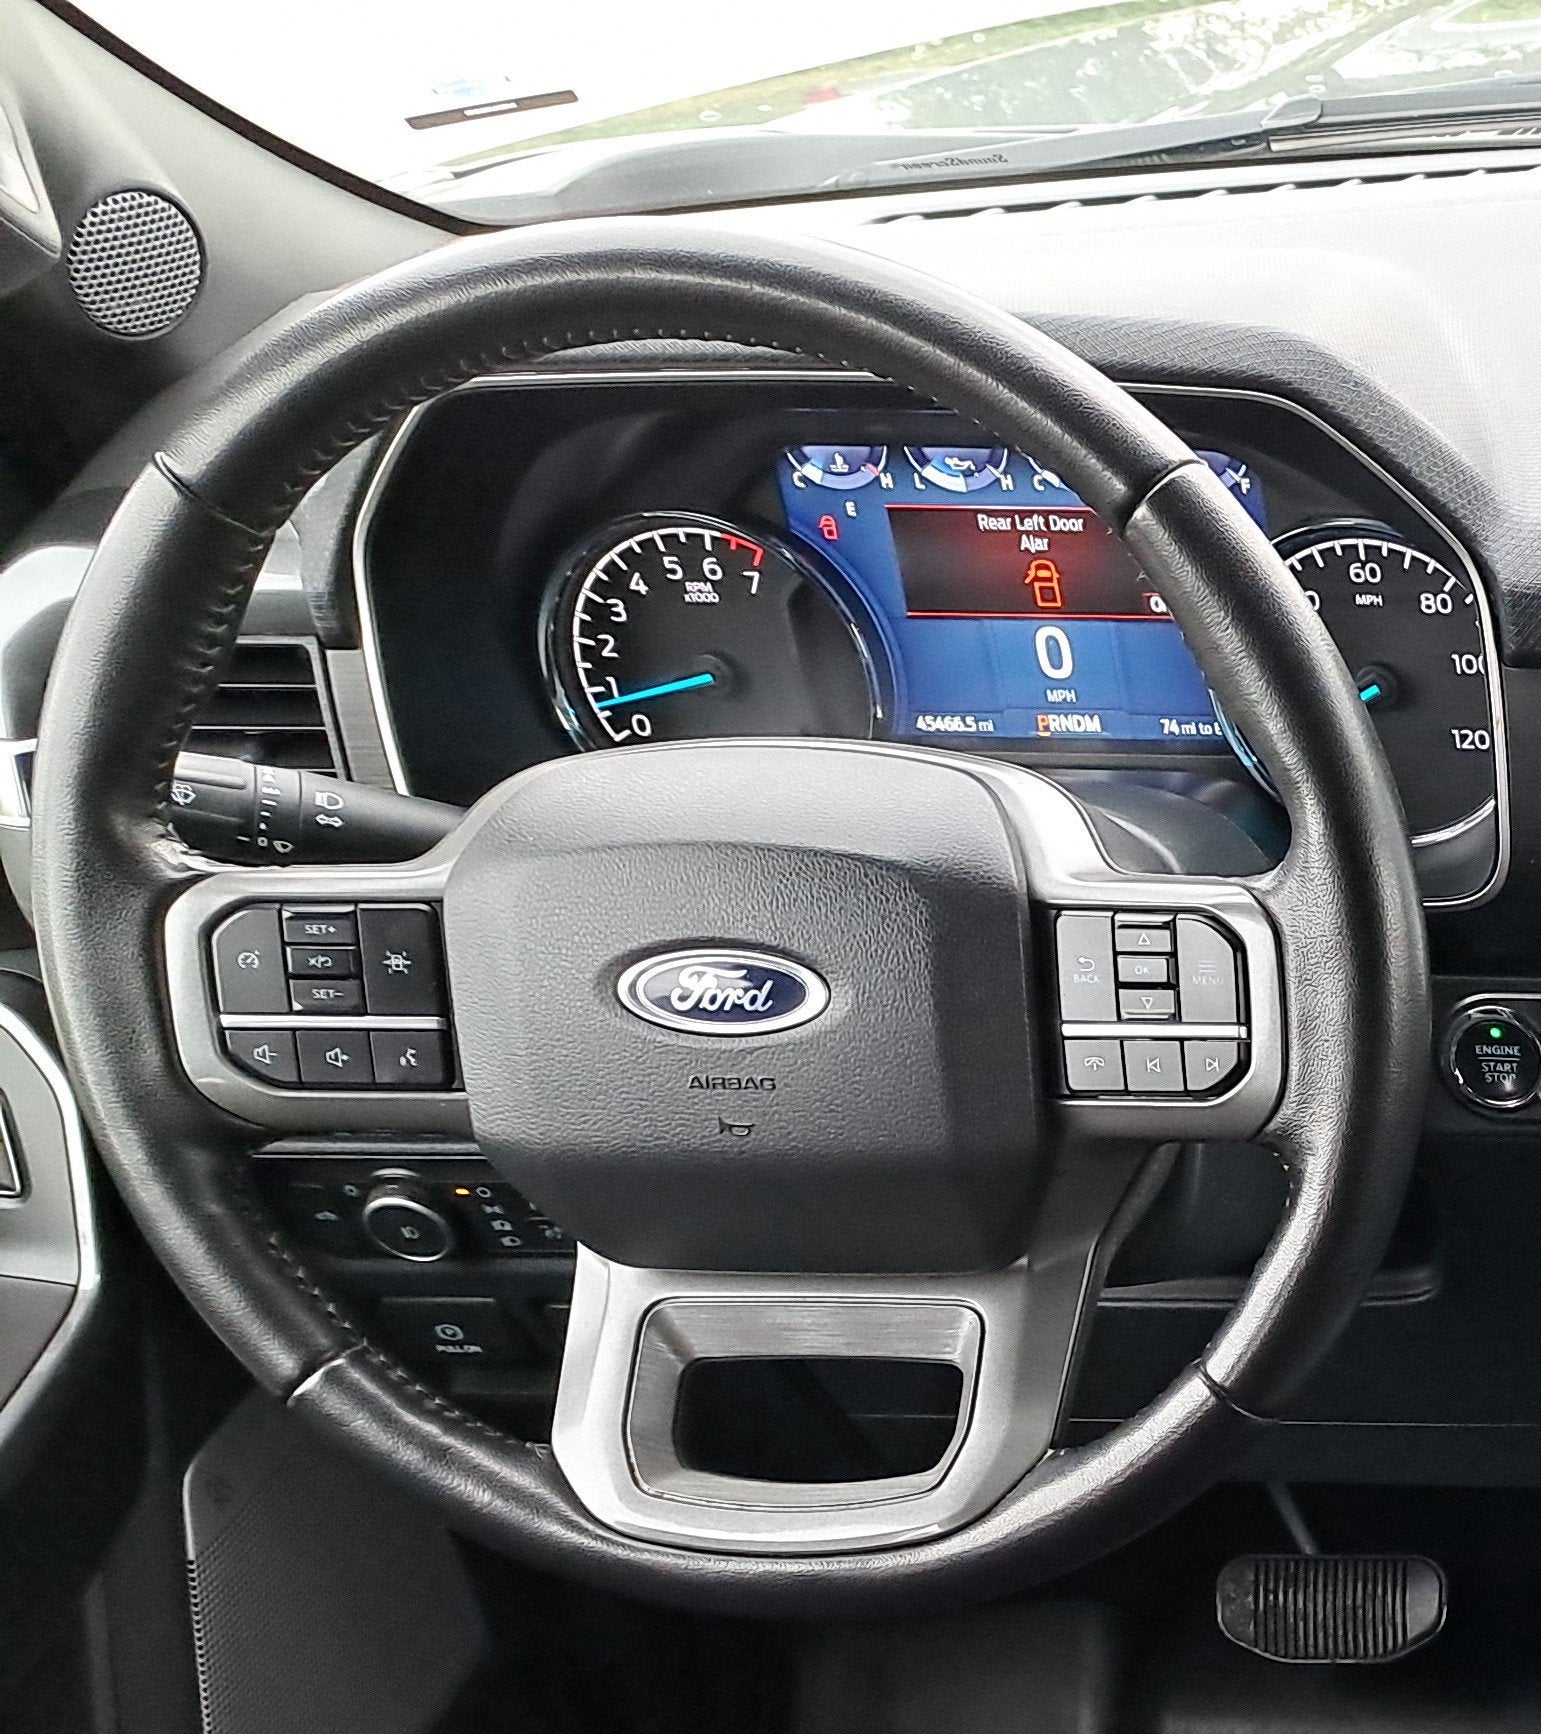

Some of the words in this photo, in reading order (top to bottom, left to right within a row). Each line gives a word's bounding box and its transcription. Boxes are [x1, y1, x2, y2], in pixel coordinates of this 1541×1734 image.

[880, 473, 894, 488] H
[1002, 475, 1014, 491] H
[977, 513, 1012, 531] Rear
[1014, 513, 1047, 531] Left
[1048, 515, 1084, 531] Door
[1020, 533, 1049, 553] Ajar
[662, 556, 684, 580] 5
[702, 557, 723, 581] 6
[1349, 561, 1382, 584] 60
[629, 572, 649, 595] 4
[684, 581, 714, 593] RPM
[741, 571, 760, 595] 7
[606, 598, 628, 622] 3
[1354, 593, 1384, 607] MPH
[1419, 592, 1453, 614] 80
[596, 634, 620, 657] 2
[1034, 625, 1073, 680] 0
[605, 676, 619, 699] 1
[1046, 688, 1077, 703] MPH
[631, 713, 652, 737] 0
[1160, 718, 1180, 736] 74
[1451, 729, 1490, 750] 120
[669, 965, 775, 1012] Ford
[1475, 1044, 1522, 1056] ENGINE
[1481, 1061, 1519, 1073] START
[688, 1075, 777, 1091] AIRBAG
[1484, 1072, 1517, 1084] STOP
